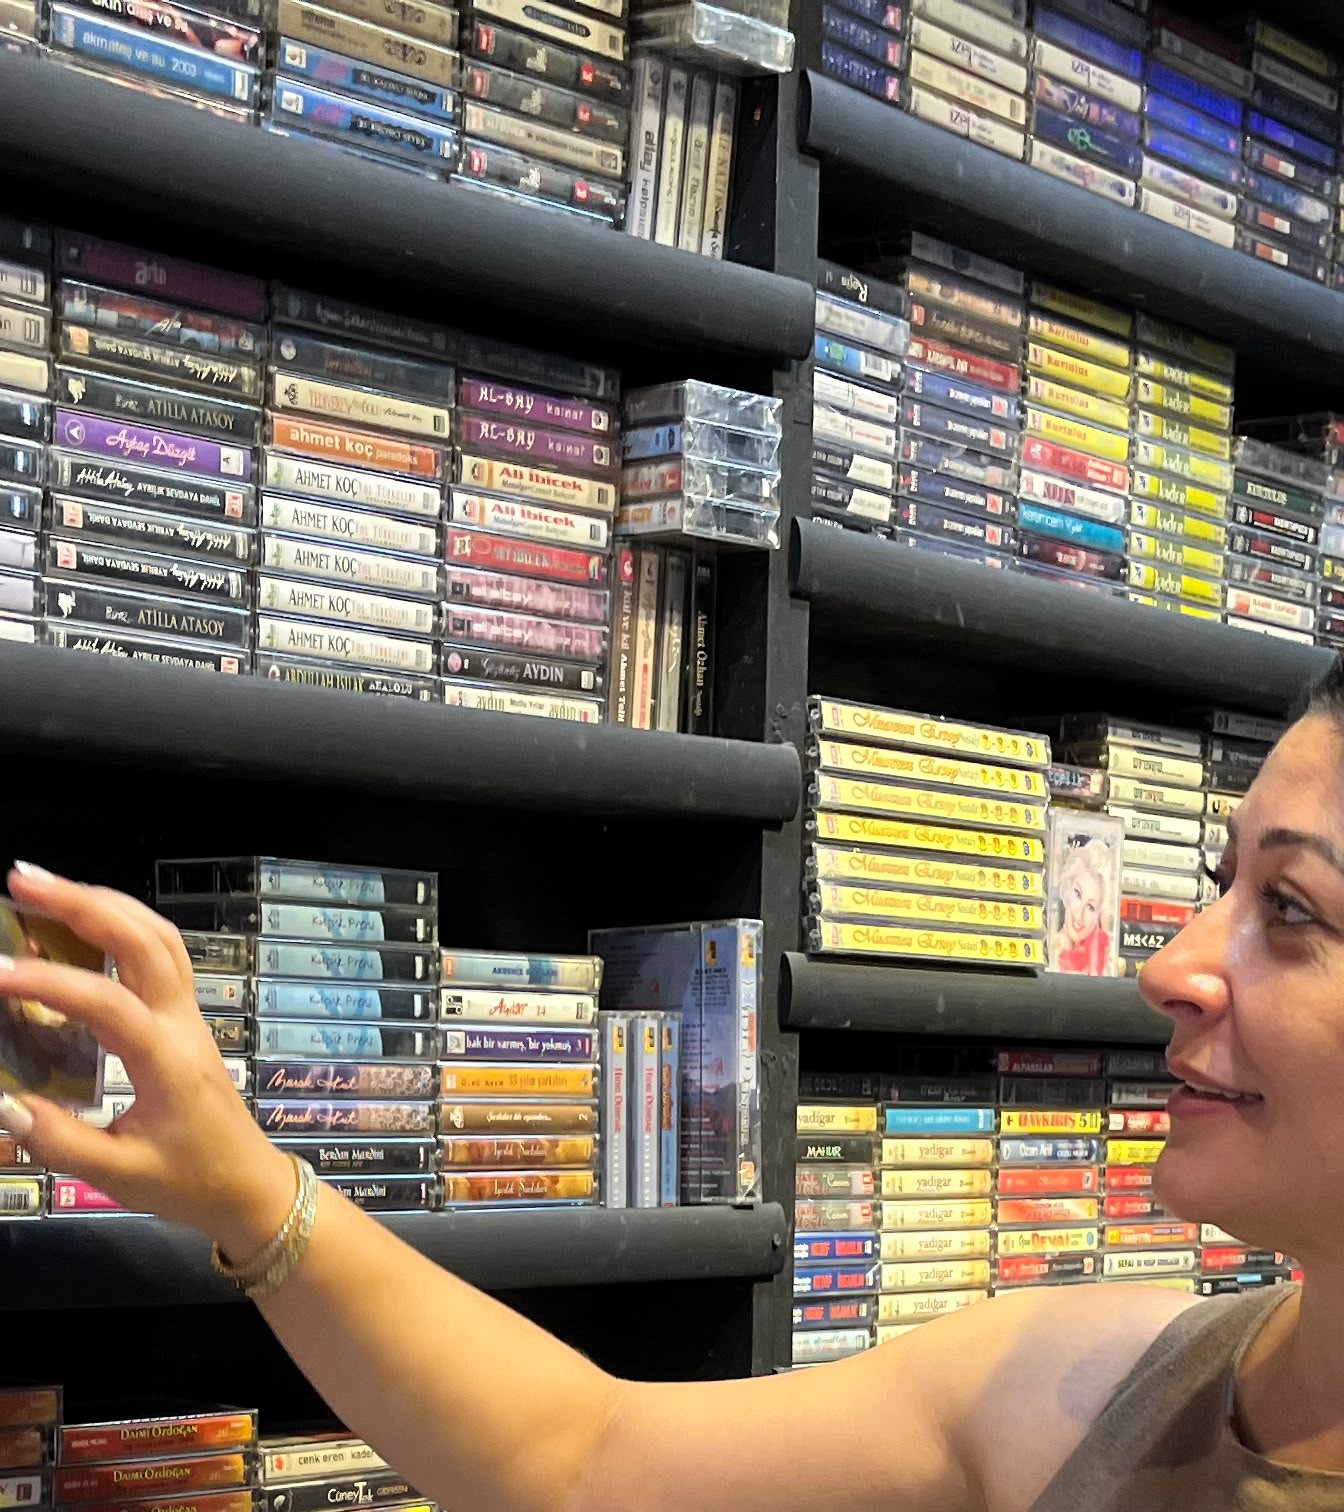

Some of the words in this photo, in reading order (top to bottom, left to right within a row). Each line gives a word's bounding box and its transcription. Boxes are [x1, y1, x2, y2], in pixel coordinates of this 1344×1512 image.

[289, 426, 342, 454] ahmet
[344, 433, 375, 461] koç
[296, 467, 332, 492] AHMET
[292, 507, 328, 532] AHMET
[180, 613, 225, 637] ATASOY
[522, 661, 565, 684] AYDIN
